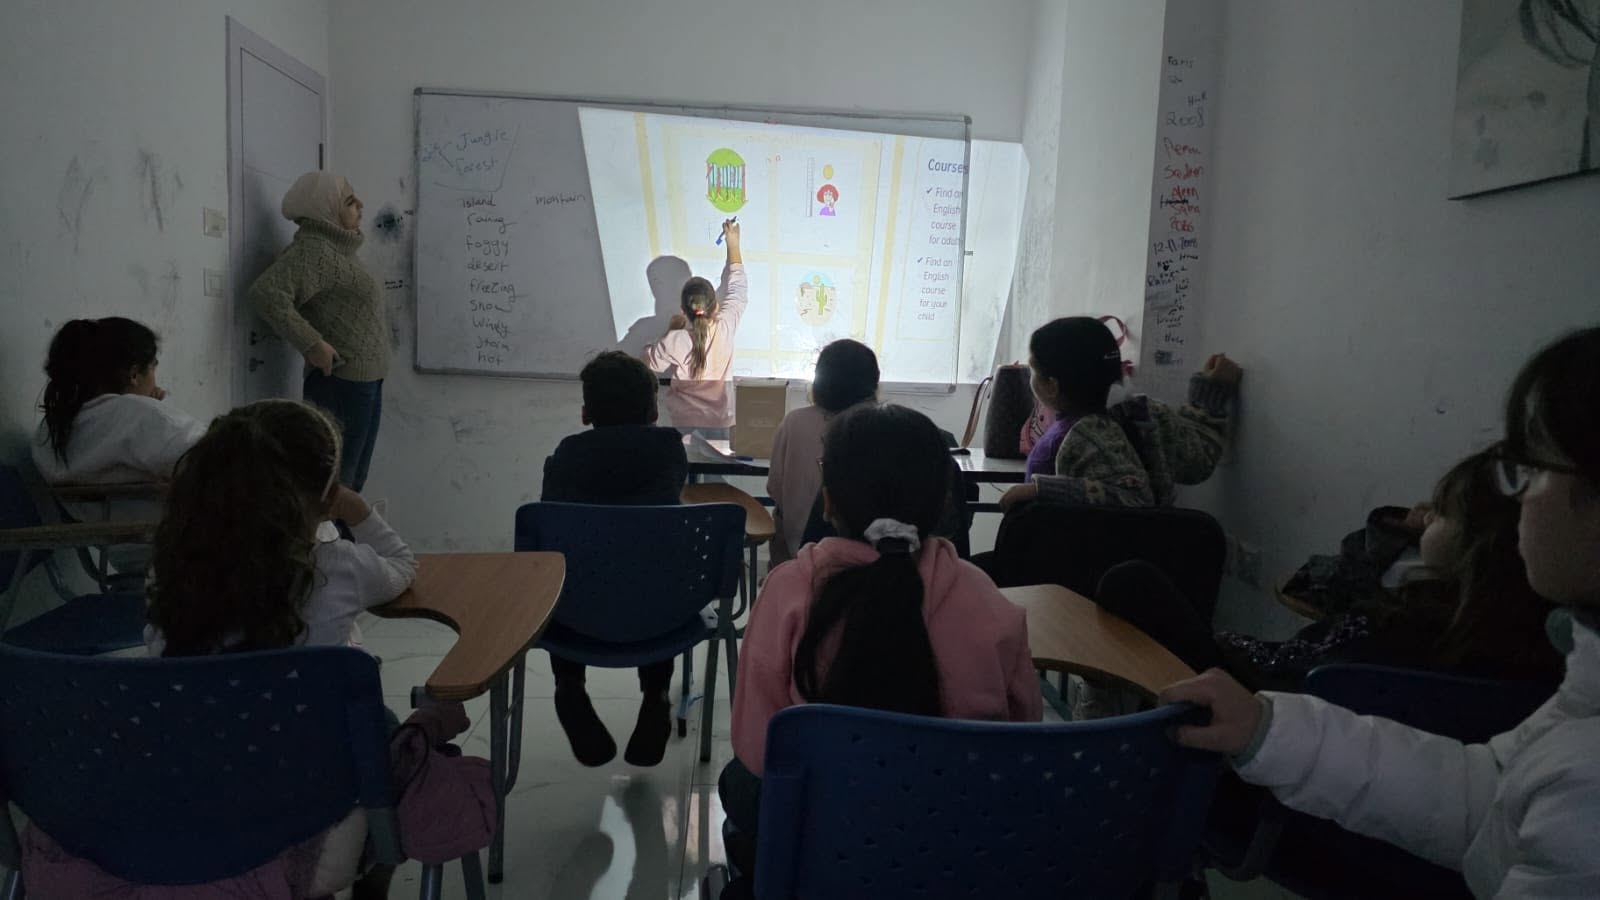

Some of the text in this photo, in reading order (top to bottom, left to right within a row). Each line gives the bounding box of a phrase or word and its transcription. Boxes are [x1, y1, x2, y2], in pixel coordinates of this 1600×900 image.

[927, 157, 970, 175] Courses
[935, 186, 953, 199] Find
[932, 202, 962, 217] English
[930, 221, 957, 231] course
[929, 234, 940, 245] for
[466, 234, 510, 257] foggy
[925, 256, 953, 267] Find an
[923, 271, 950, 282] English
[921, 287, 946, 296] course
[919, 298, 948, 310] for your
[917, 311, 936, 321] child
